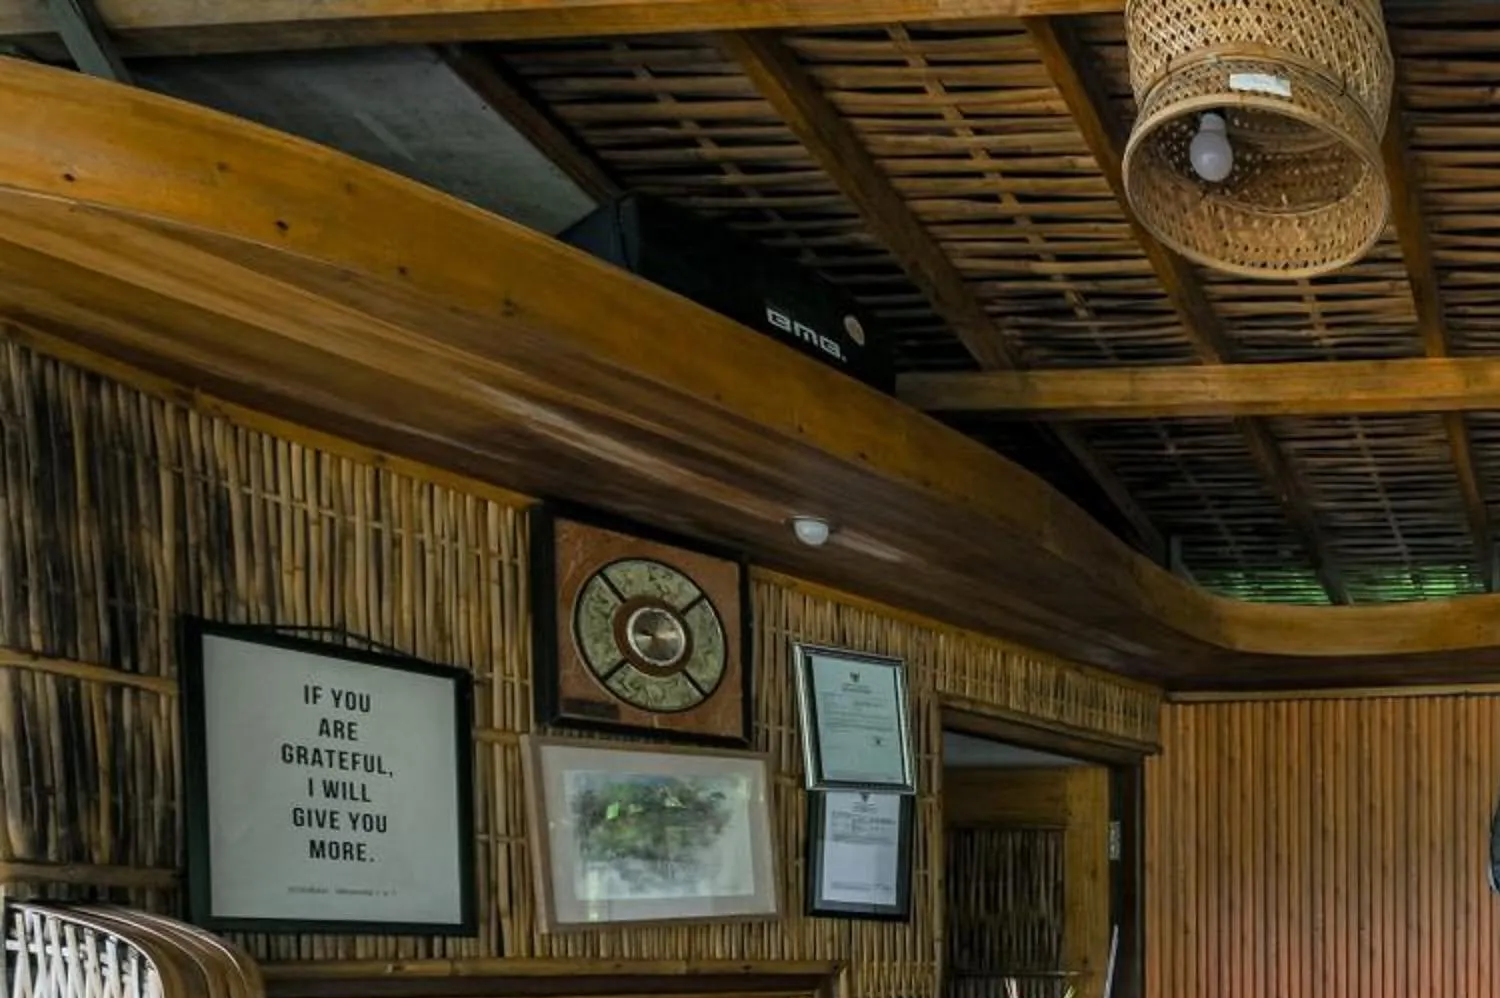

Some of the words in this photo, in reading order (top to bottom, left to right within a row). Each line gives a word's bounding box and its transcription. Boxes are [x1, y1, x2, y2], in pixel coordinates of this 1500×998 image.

[302, 684, 322, 705] IF
[330, 688, 372, 713] YOU
[318, 718, 358, 741] ARE
[281, 743, 393, 778] GRATEFUL,
[308, 777, 314, 798] I
[322, 779, 371, 802] WILL
[292, 807, 340, 830] GIVE
[349, 811, 388, 834] YOU
[308, 839, 375, 863] MORE.
